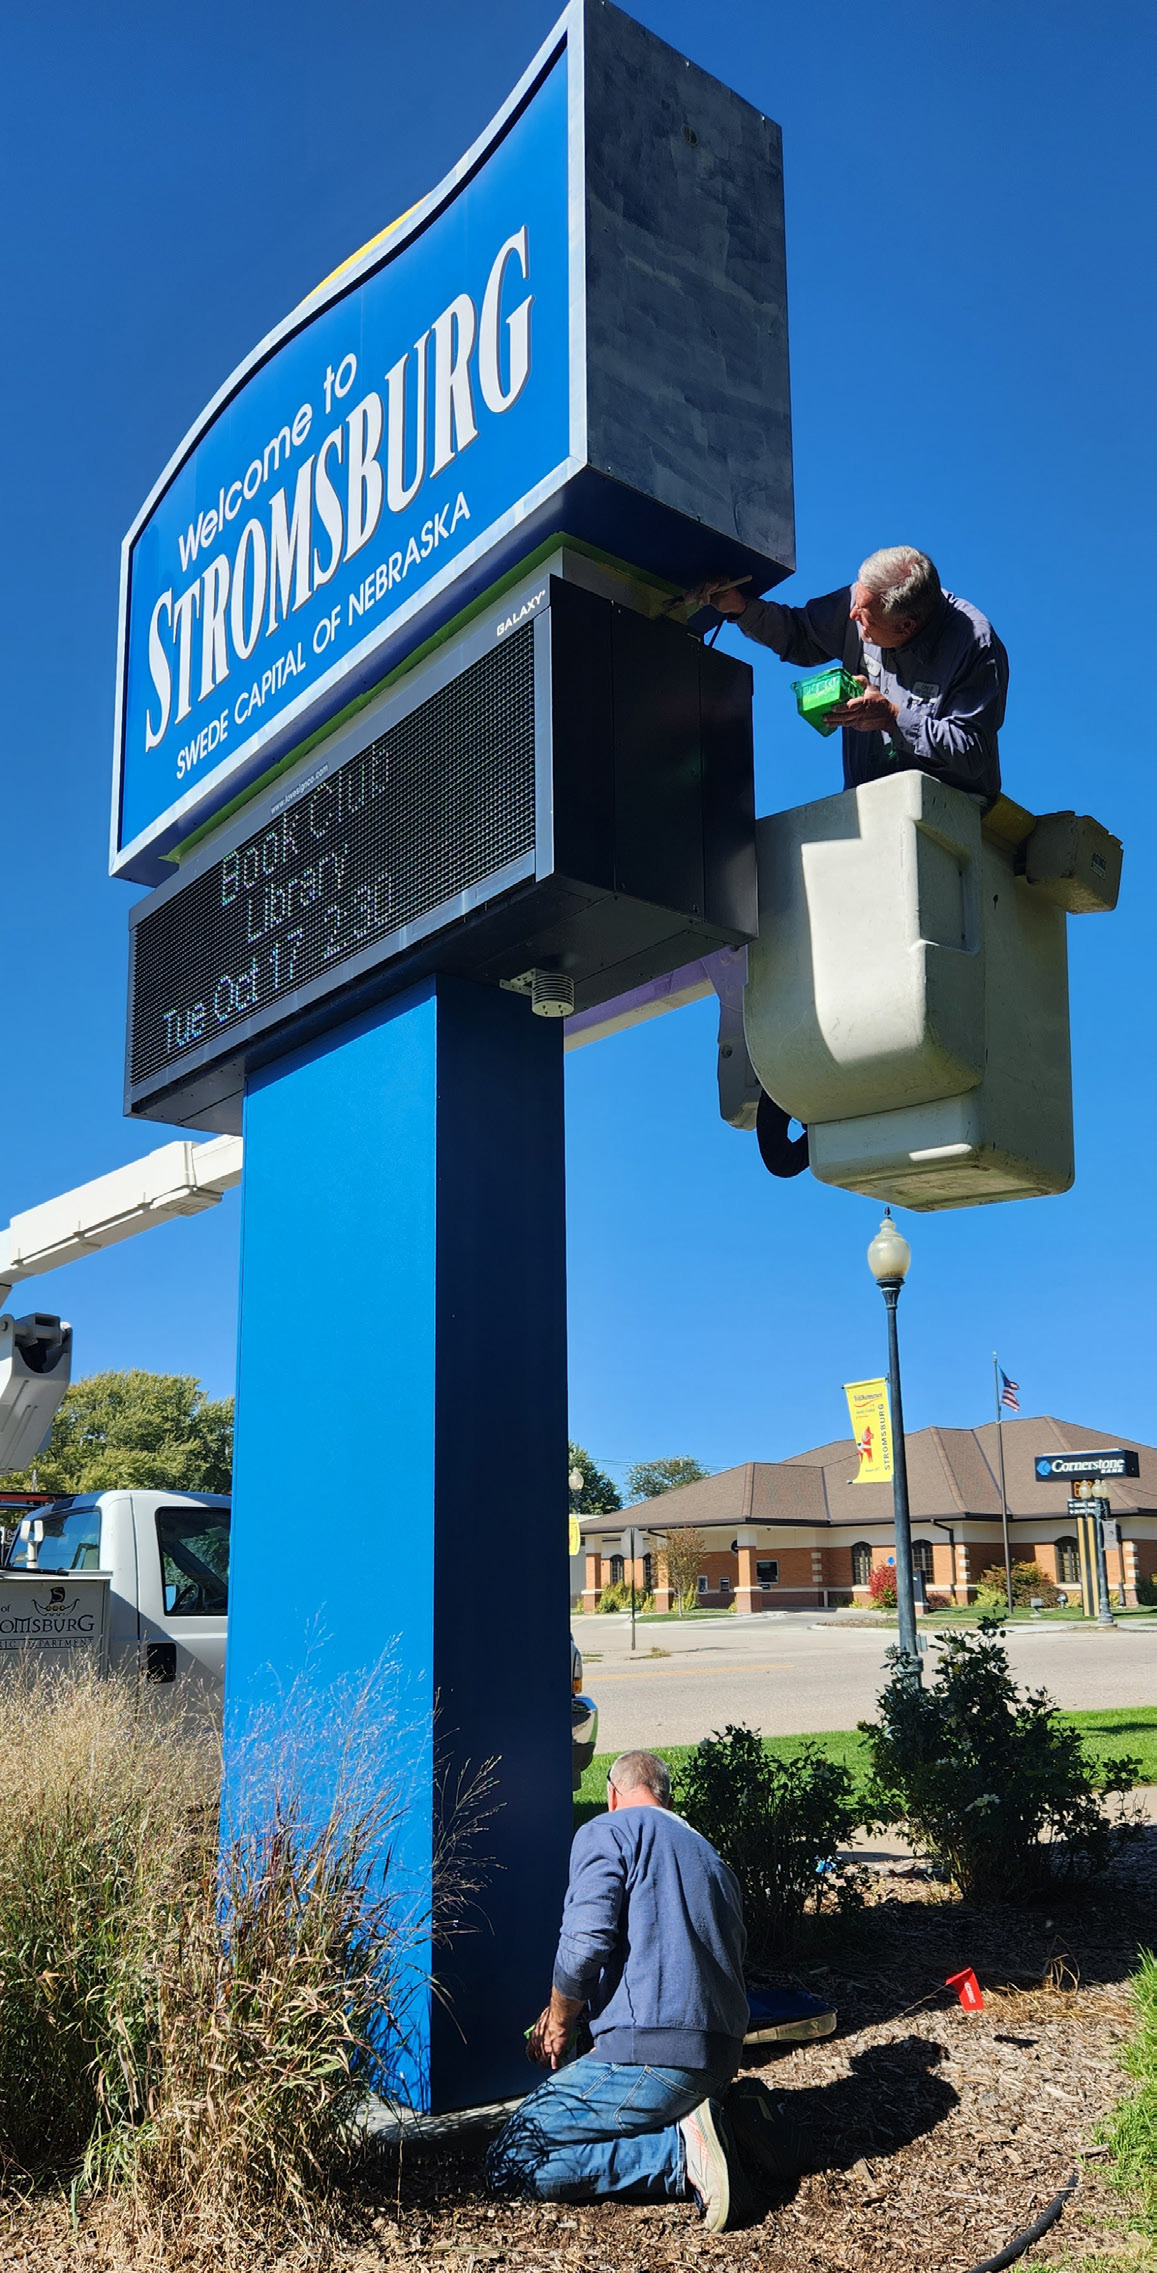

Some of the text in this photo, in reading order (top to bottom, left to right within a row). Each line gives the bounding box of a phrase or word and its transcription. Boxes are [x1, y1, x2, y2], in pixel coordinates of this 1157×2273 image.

[145, 225, 536, 753] STROMSBURG
[178, 353, 357, 573] Welcome to
[176, 491, 471, 780] SWEDE CAPITAL OF NEBRASKA
[222, 744, 390, 907] Book Club
[247, 843, 349, 944] Library
[163, 1003, 205, 1053] Tue
[214, 957, 259, 1023] Oct
[269, 928, 303, 989] 17
[878, 1403, 890, 1470] STROMSBURG
[1051, 1459, 1125, 1473] Cornerstone
[0, 1604, 11, 1613] of
